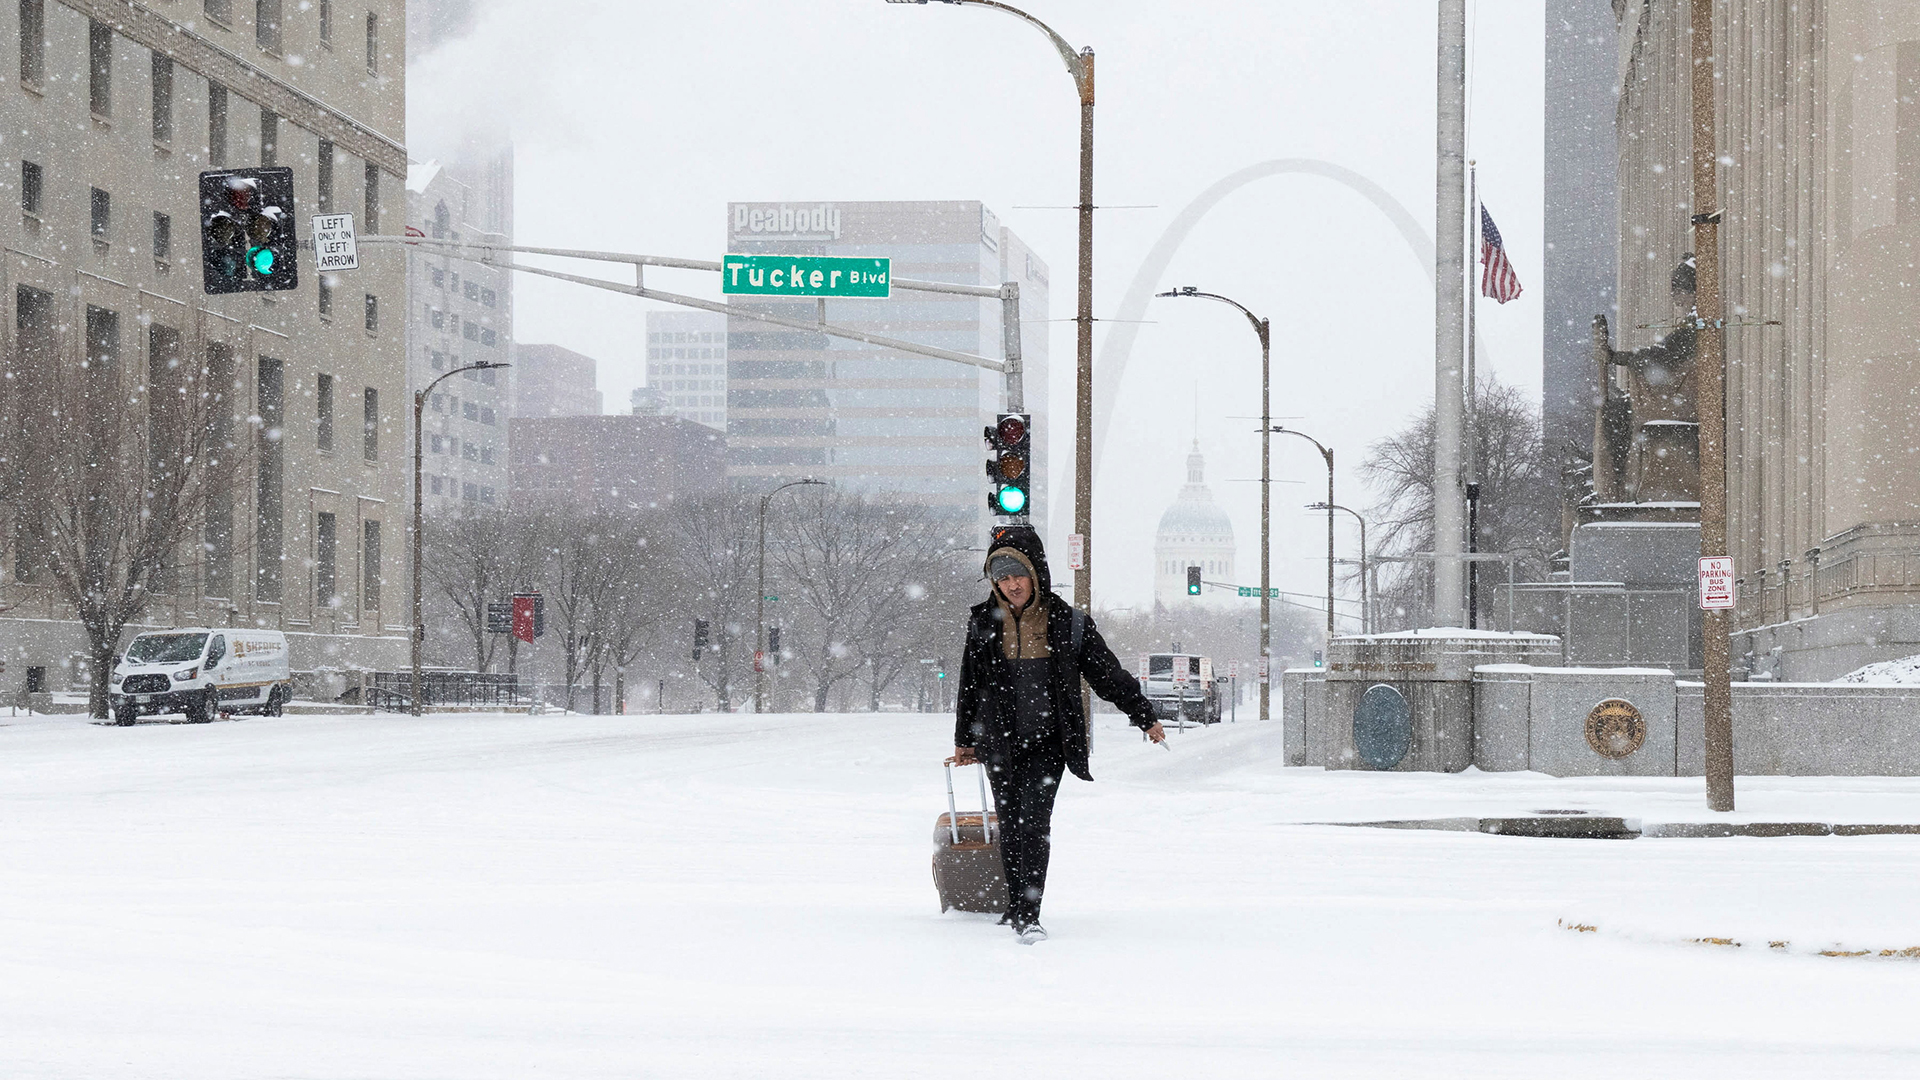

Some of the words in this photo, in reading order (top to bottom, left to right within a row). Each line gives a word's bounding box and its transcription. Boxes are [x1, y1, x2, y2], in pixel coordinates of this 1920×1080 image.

[321, 217, 345, 230] LEFT
[734, 204, 842, 240] Peabody
[318, 231, 336, 242] ONLY
[341, 230, 352, 240] ON
[324, 241, 347, 254] LEFT
[321, 254, 355, 267] ARROW
[727, 262, 842, 289] Tucker
[850, 270, 887, 284] Blvd
[1710, 561, 1722, 570] NO
[1702, 570, 1731, 578] PARKING
[245, 641, 282, 653] SHERIFF
